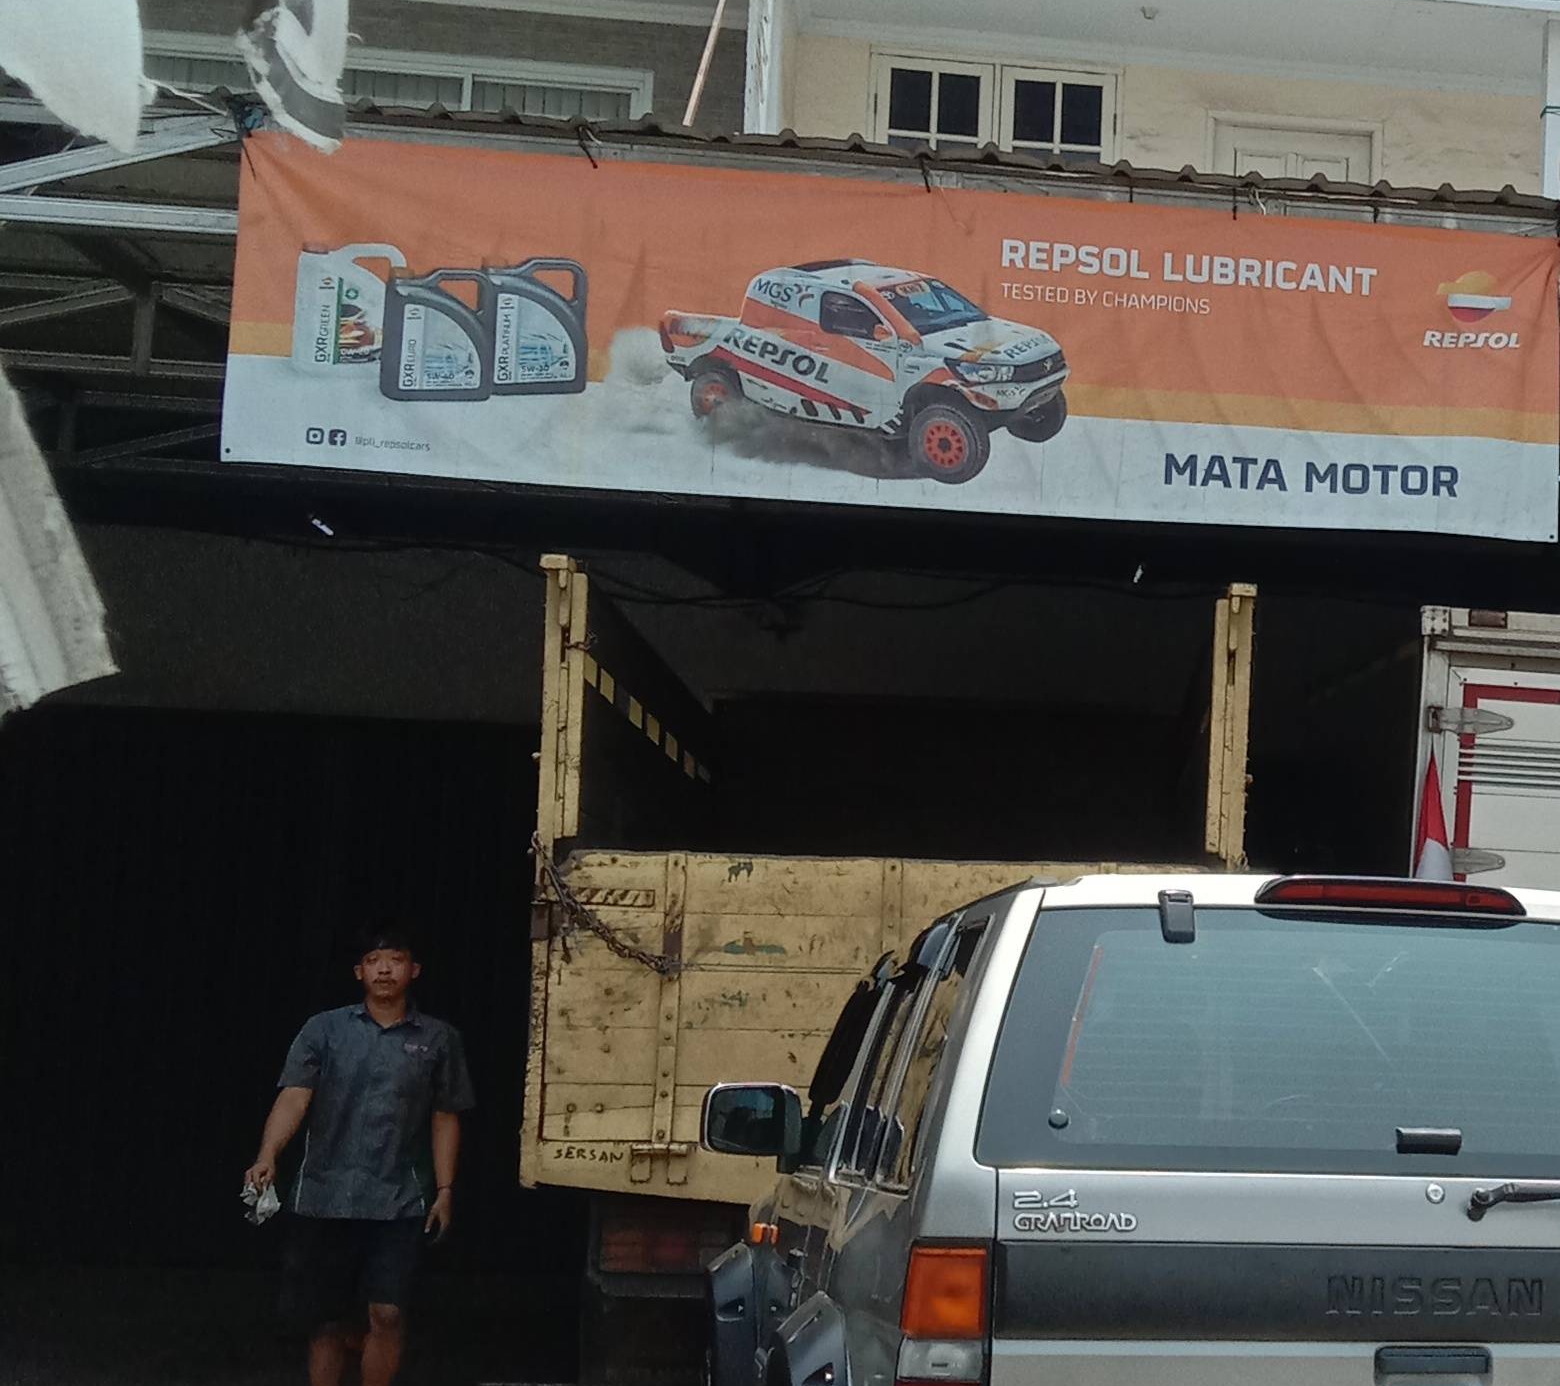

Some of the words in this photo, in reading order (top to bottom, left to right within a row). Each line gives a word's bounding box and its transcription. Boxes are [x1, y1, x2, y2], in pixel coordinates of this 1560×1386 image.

[1001, 239, 1150, 280] REPSOL
[1163, 252, 1378, 296] LUBRICANT
[752, 276, 794, 304] MGS
[1001, 282, 1067, 304] TESTED
[1073, 286, 1098, 306] BY
[1102, 289, 1211, 316] CHAMPIONS
[723, 328, 831, 385] REPSOL
[1422, 329, 1521, 351] REPSOL
[1164, 452, 1288, 492] MATA
[1303, 463, 1459, 499] MOTOR
[553, 1144, 624, 1164] SERSAN
[1014, 1188, 1079, 1208] 2.4
[1325, 1274, 1544, 1316] NISSAN
